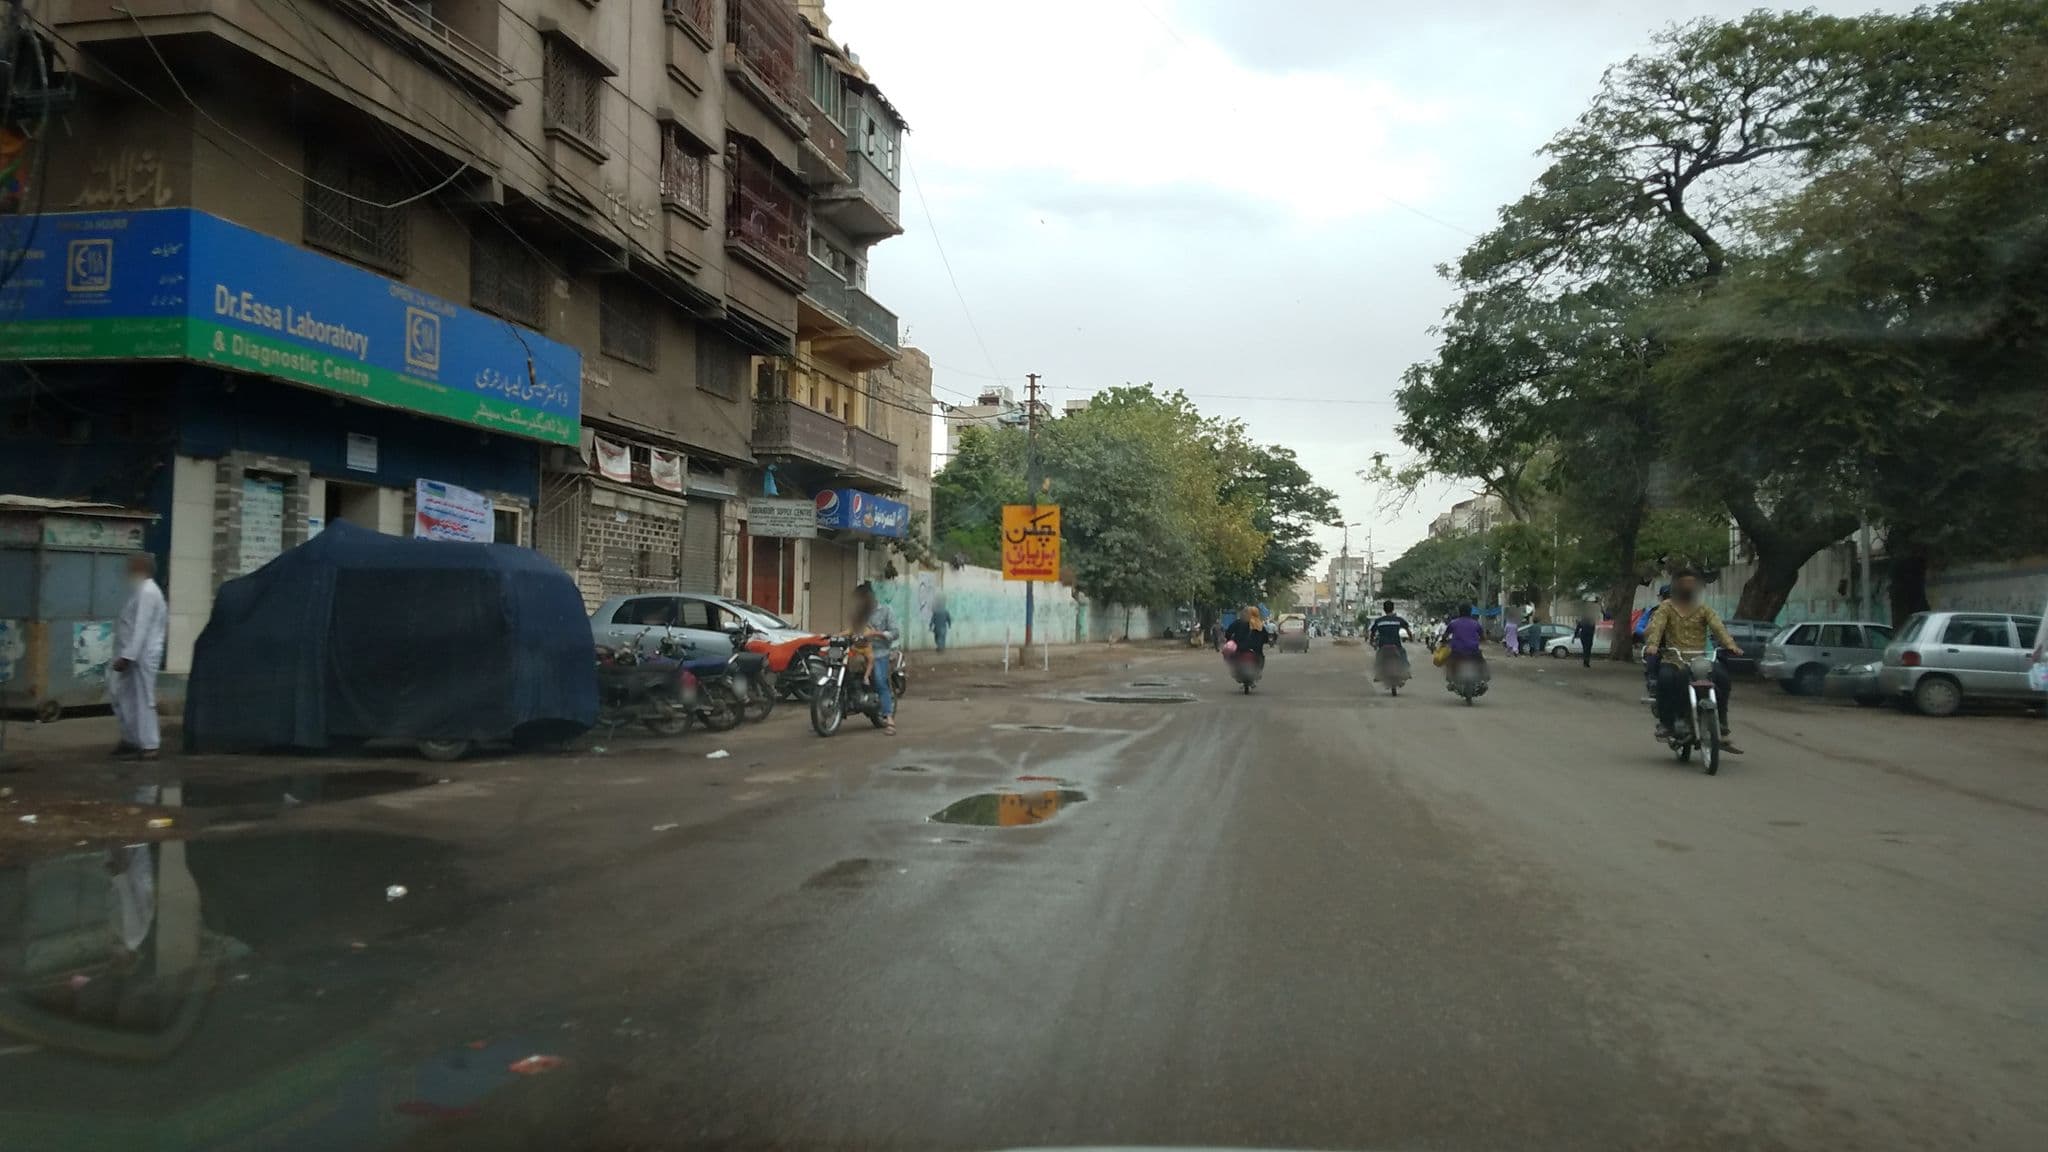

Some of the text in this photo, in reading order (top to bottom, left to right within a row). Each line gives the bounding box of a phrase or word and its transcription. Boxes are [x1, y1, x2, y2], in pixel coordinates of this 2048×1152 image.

[215, 283, 369, 361] Dr.Essa Laboratory
[213, 330, 226, 352] &
[232, 334, 320, 374] Diagnostic
[323, 359, 369, 388] Centre
[1005, 511, 1057, 547] چکن
